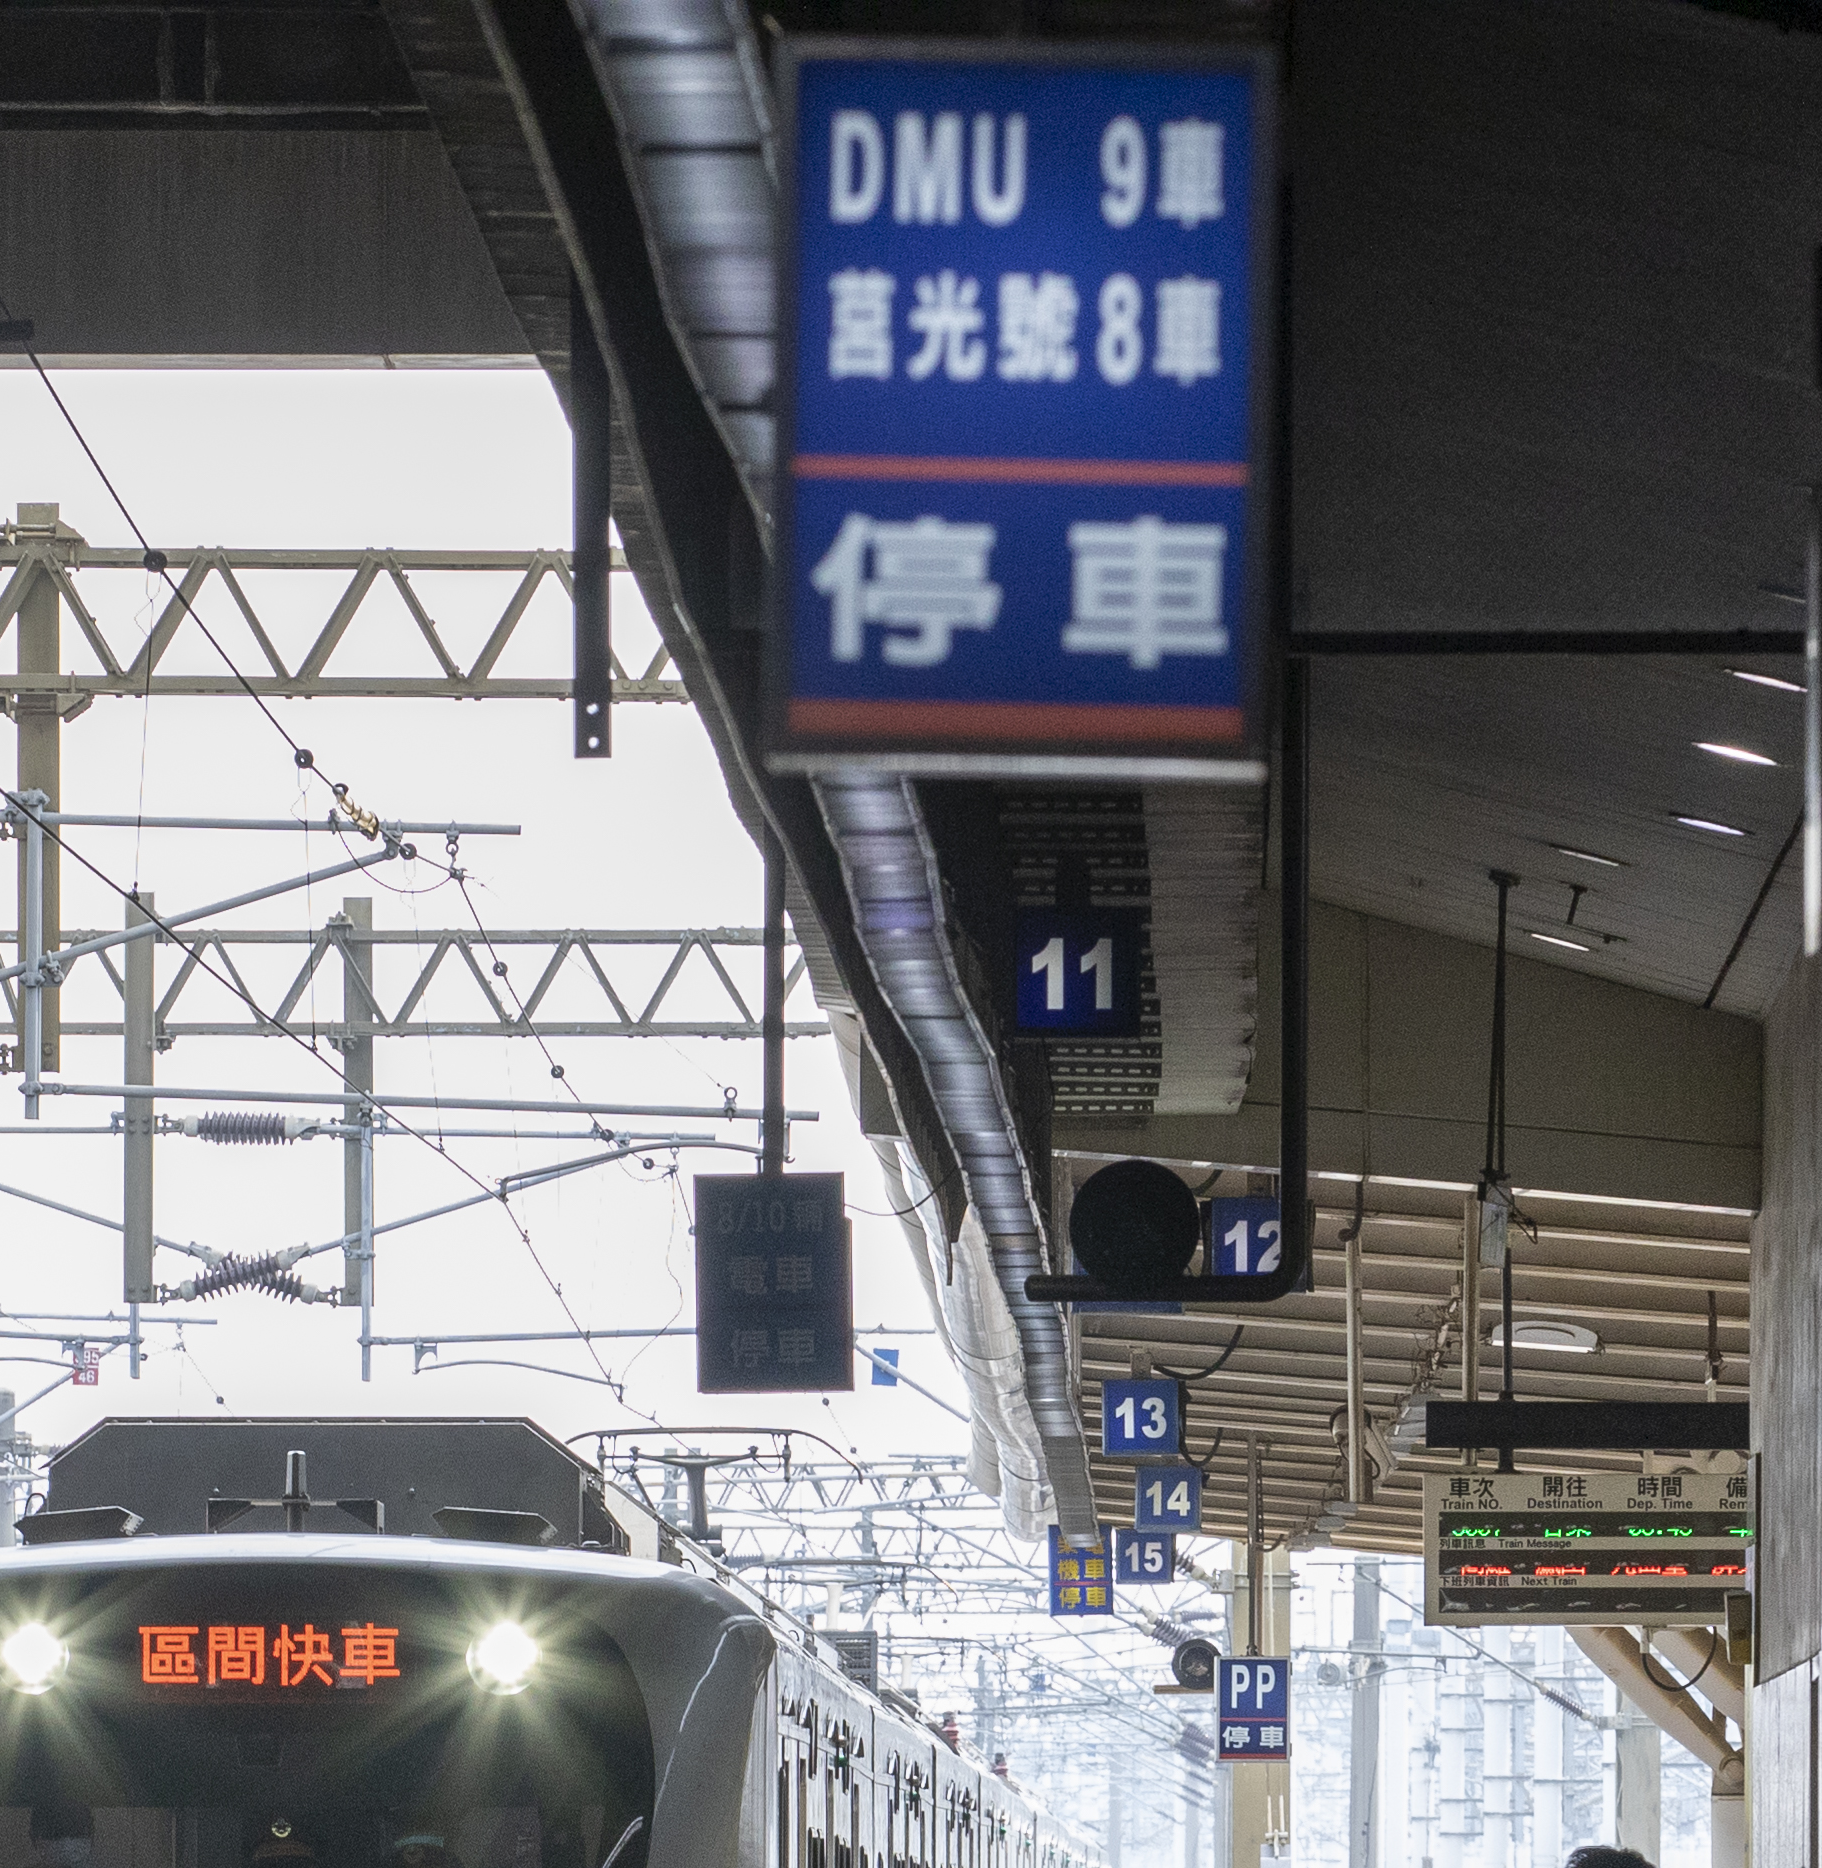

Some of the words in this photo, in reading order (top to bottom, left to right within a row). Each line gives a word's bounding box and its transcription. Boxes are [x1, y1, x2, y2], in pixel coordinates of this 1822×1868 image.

[829, 110, 1028, 225] DMU
[1100, 115, 1226, 229] 9車
[812, 512, 1230, 669] 停車
[1031, 937, 1113, 1010] 11
[1224, 1220, 1280, 1273] 12
[1115, 1397, 1167, 1439] 13
[1146, 1480, 1191, 1517] 14
[1449, 1477, 1495, 1498] 車次
[1542, 1476, 1588, 1498] 開往
[1637, 1476, 1682, 1498] 時間
[1441, 1498, 1474, 1510] Train
[1478, 1498, 1503, 1510] NO.
[1527, 1498, 1603, 1509] Destination
[1627, 1498, 1657, 1512] Dep.
[1661, 1498, 1693, 1510] Time
[1499, 1539, 1523, 1548] Train
[1527, 1539, 1572, 1549] Message
[1125, 1541, 1163, 1573] 15
[1521, 1576, 1548, 1586] Next
[1552, 1576, 1577, 1586] Train
[1059, 1586, 1107, 1609] 停車
[138, 1622, 401, 1687] 區間快車
[1231, 1664, 1276, 1709] PP
[1222, 1725, 1284, 1749] 停車
